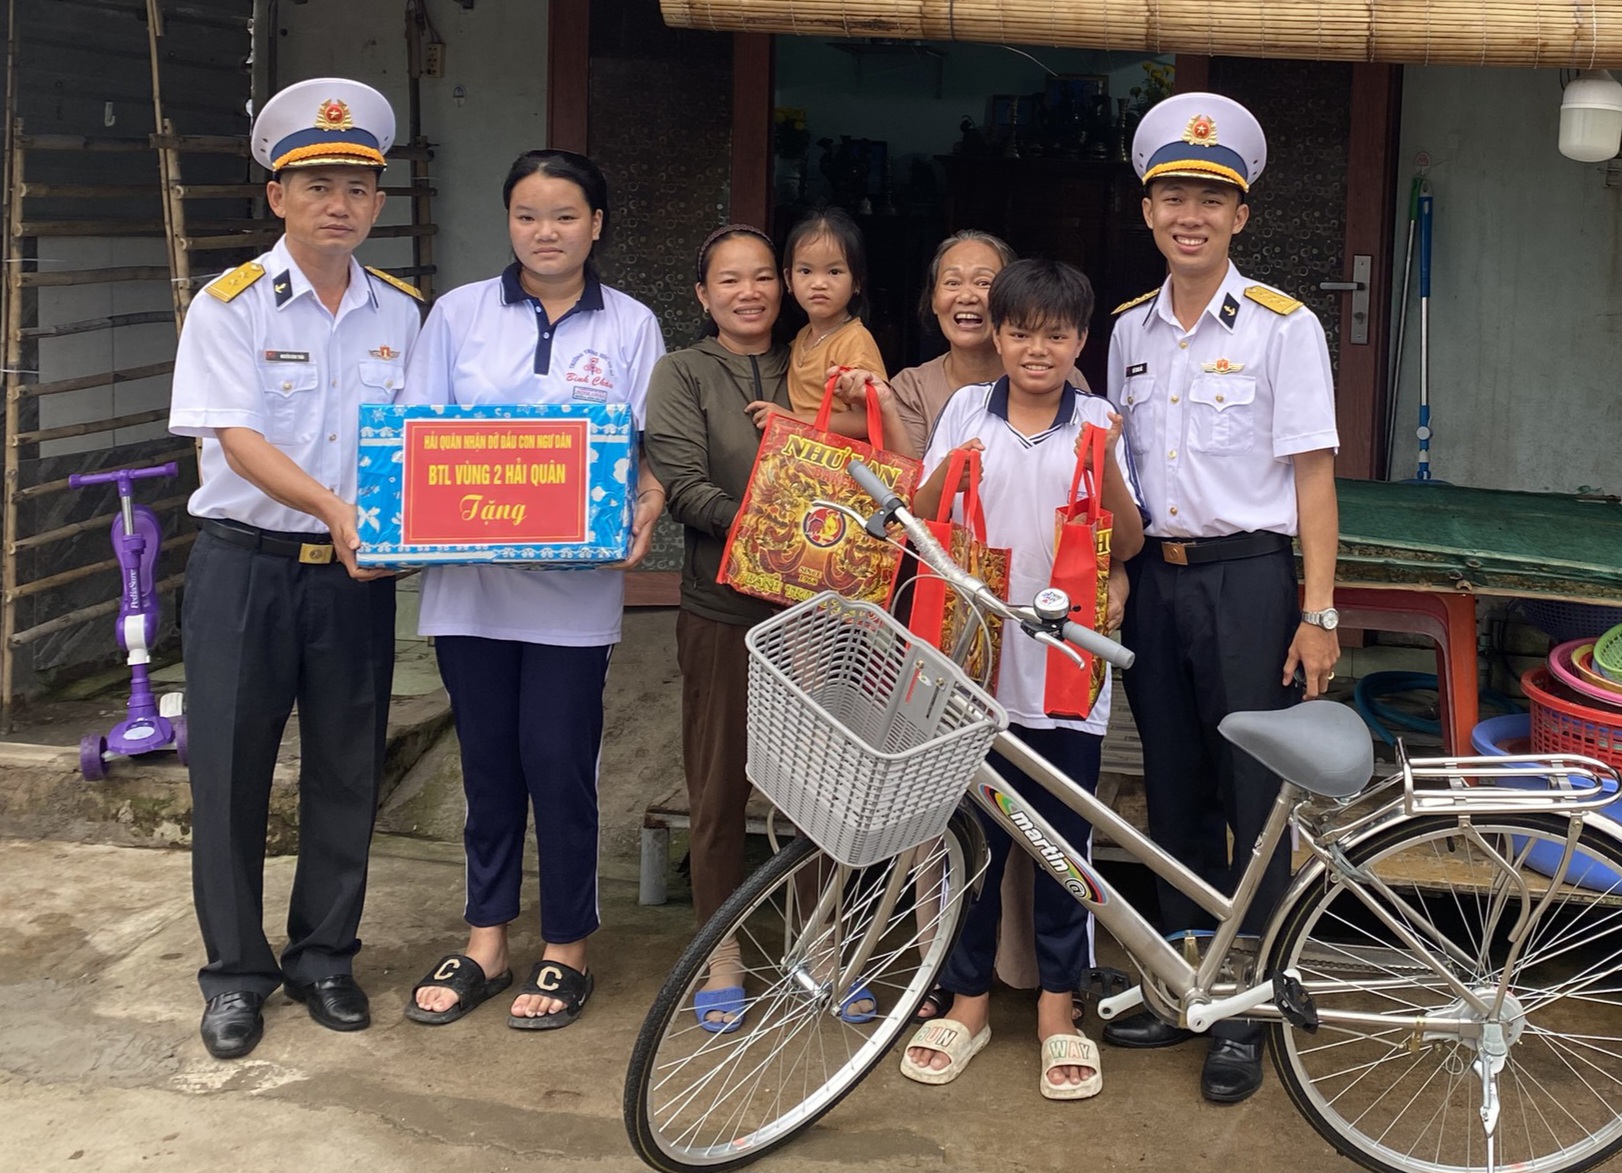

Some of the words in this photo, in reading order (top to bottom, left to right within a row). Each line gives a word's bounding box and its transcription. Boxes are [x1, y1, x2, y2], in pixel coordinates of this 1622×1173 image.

[424, 430, 438, 449] HẢI
[440, 432, 462, 451] QUÂN
[464, 432, 486, 452] NHẬN
[519, 434, 536, 449] CON
[537, 433, 555, 449] NGƯ
[555, 432, 572, 449] DÂN
[782, 435, 852, 470] NHƯ
[428, 464, 451, 485] BTL
[455, 460, 490, 485] VÙNG
[493, 464, 502, 485] 2
[505, 457, 527, 484] HẢI
[531, 459, 566, 486] QUÂN
[459, 494, 528, 526] Tặng
[1008, 811, 1070, 872] martin
[914, 1026, 958, 1047] RUN
[1050, 1040, 1090, 1060] WAY
